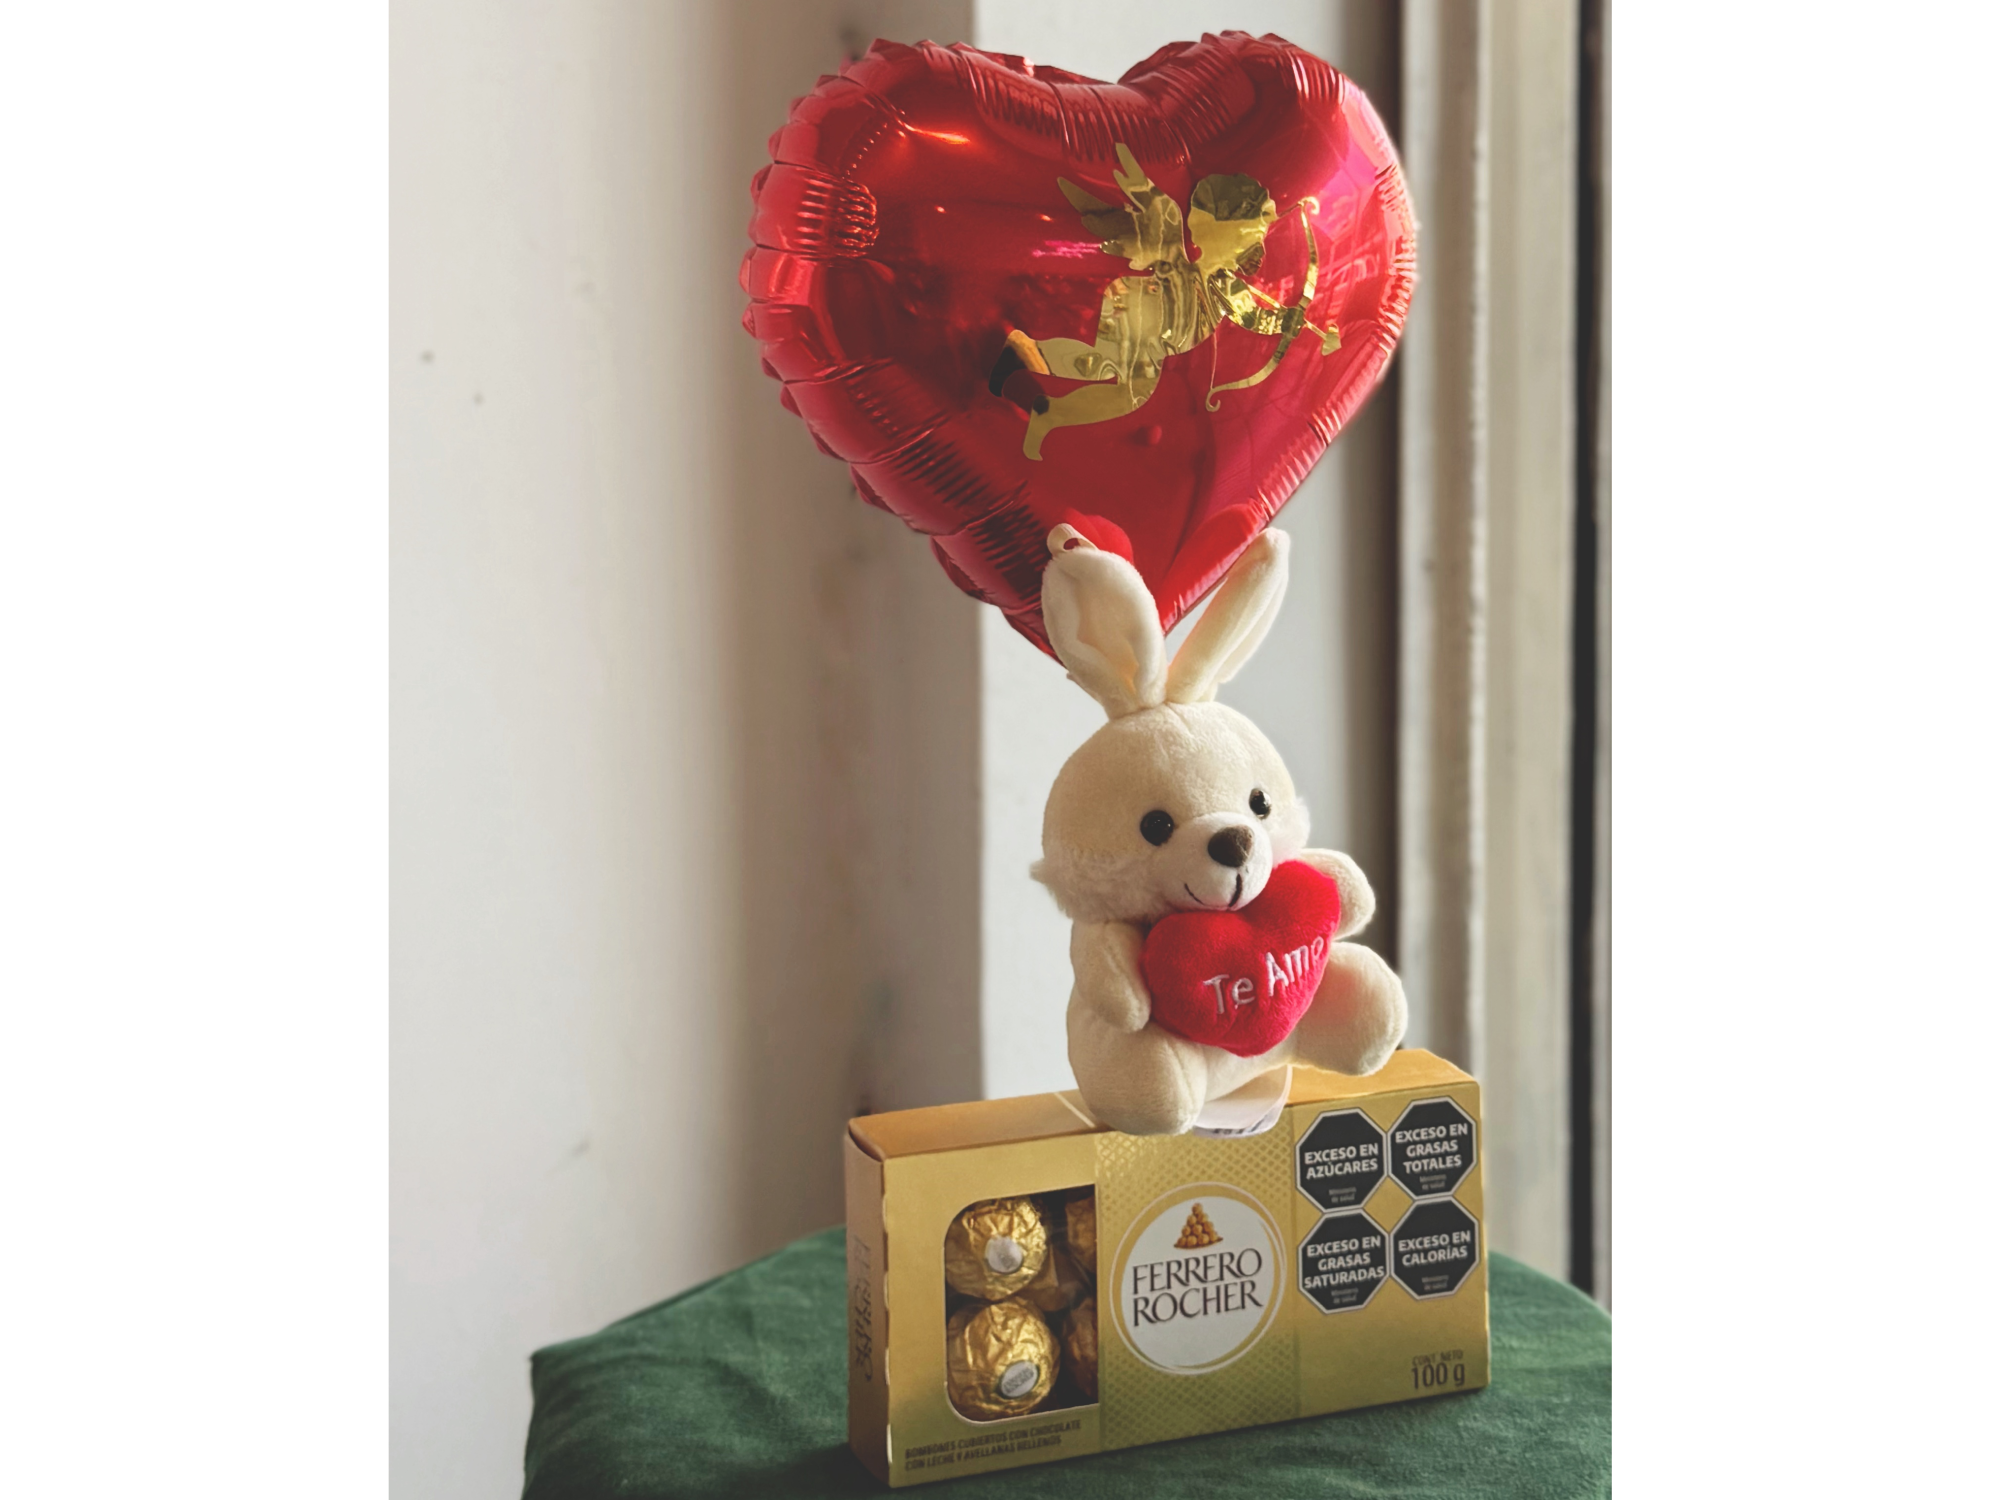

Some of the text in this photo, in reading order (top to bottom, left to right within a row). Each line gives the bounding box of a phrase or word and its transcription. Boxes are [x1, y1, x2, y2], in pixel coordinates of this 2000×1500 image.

[1203, 936, 1324, 1014] Te Amo
[1395, 1123, 1468, 1143] EXCESO EN
[1305, 1143, 1378, 1164] EXCESO EN
[1406, 1140, 1458, 1157] GRASAS
[1306, 1158, 1378, 1179] AZÚCARES
[1403, 1155, 1462, 1173] TOTALES
[1307, 1235, 1381, 1257] EXCESO EN
[1398, 1230, 1471, 1252] EXCESO EN
[1318, 1252, 1371, 1270] GRASAS
[1402, 1245, 1467, 1266] CALORÍAS
[1133, 1248, 1262, 1294] FERRERO
[1304, 1266, 1384, 1288] SATURADAS
[1134, 1280, 1263, 1326] ROCHER
[1412, 1362, 1465, 1389] 100 g
[1009, 1429, 1028, 1441] CON
[1030, 1419, 1081, 1437] CHOCOLATE
[905, 1459, 925, 1471] CON
[963, 1442, 1016, 1461] AVELLANAS
